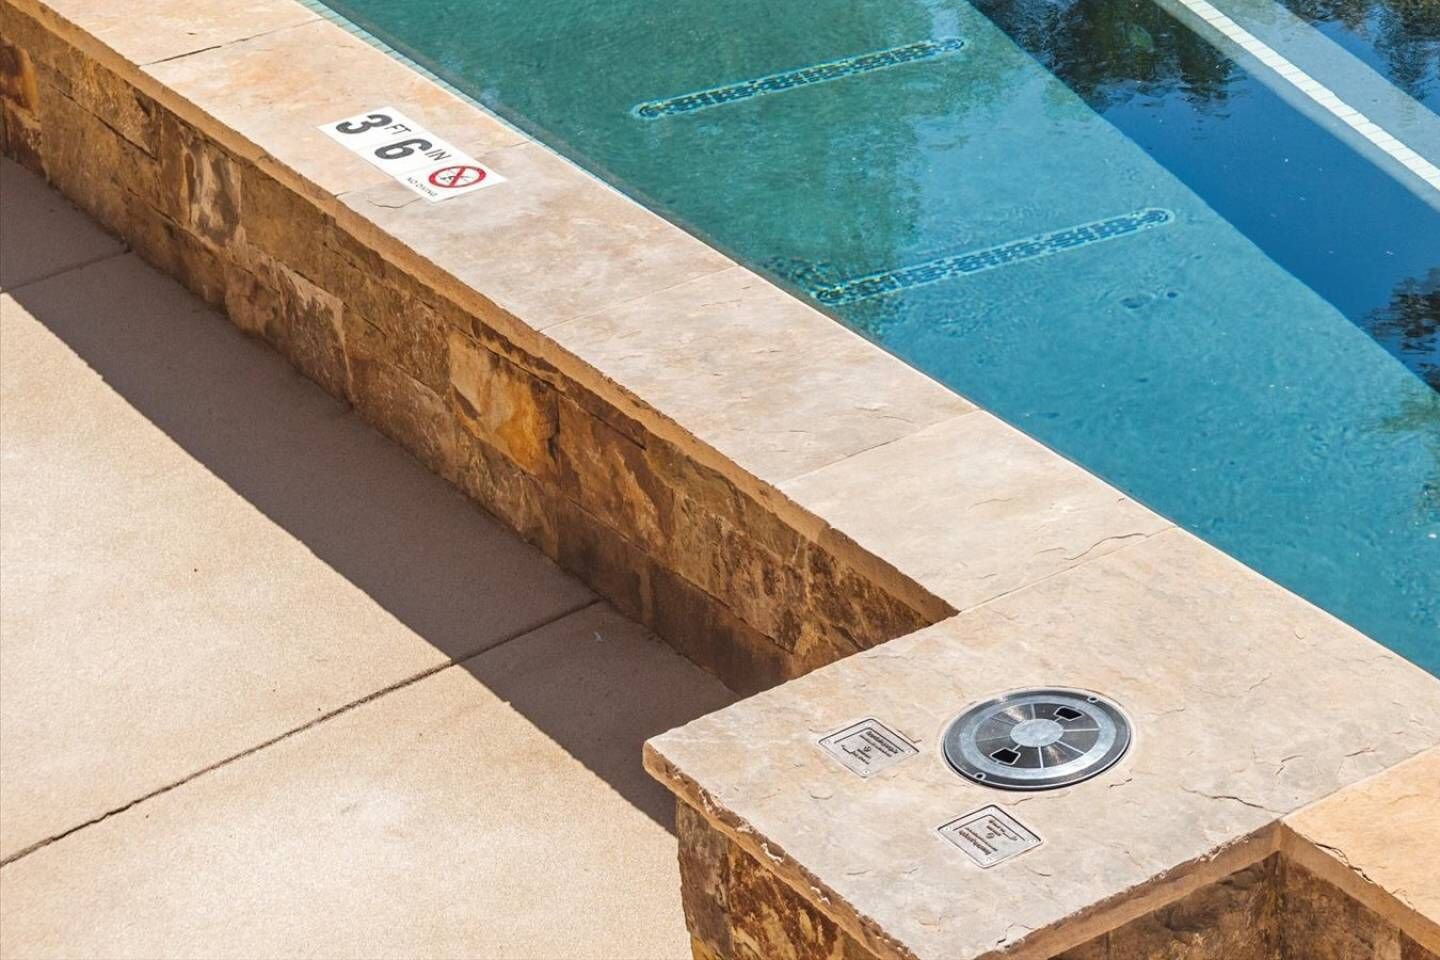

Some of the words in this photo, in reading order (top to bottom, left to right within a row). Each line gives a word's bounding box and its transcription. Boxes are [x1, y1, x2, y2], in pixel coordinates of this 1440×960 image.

[335, 113, 393, 135] 3
[384, 123, 412, 135] FT
[374, 137, 433, 161] 6
[425, 148, 453, 161] IN
